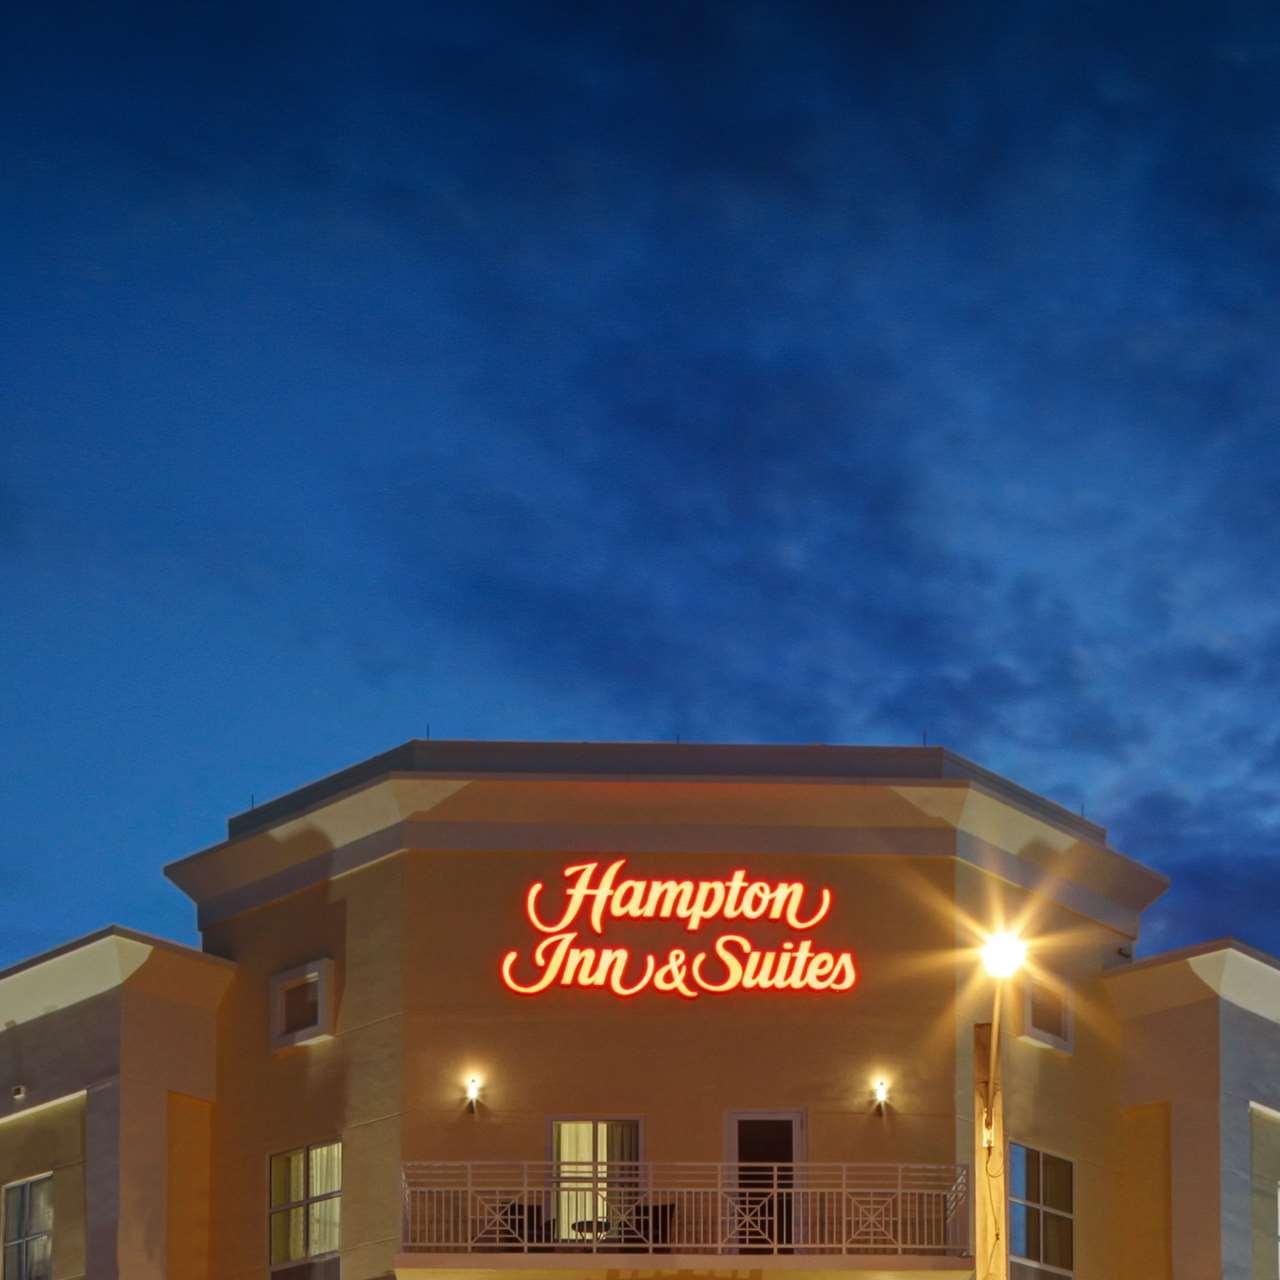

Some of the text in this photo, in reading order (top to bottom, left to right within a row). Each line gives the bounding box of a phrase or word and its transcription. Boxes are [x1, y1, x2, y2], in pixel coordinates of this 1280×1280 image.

[527, 859, 831, 933] Hampton
[502, 932, 856, 997] Inn & Suites
